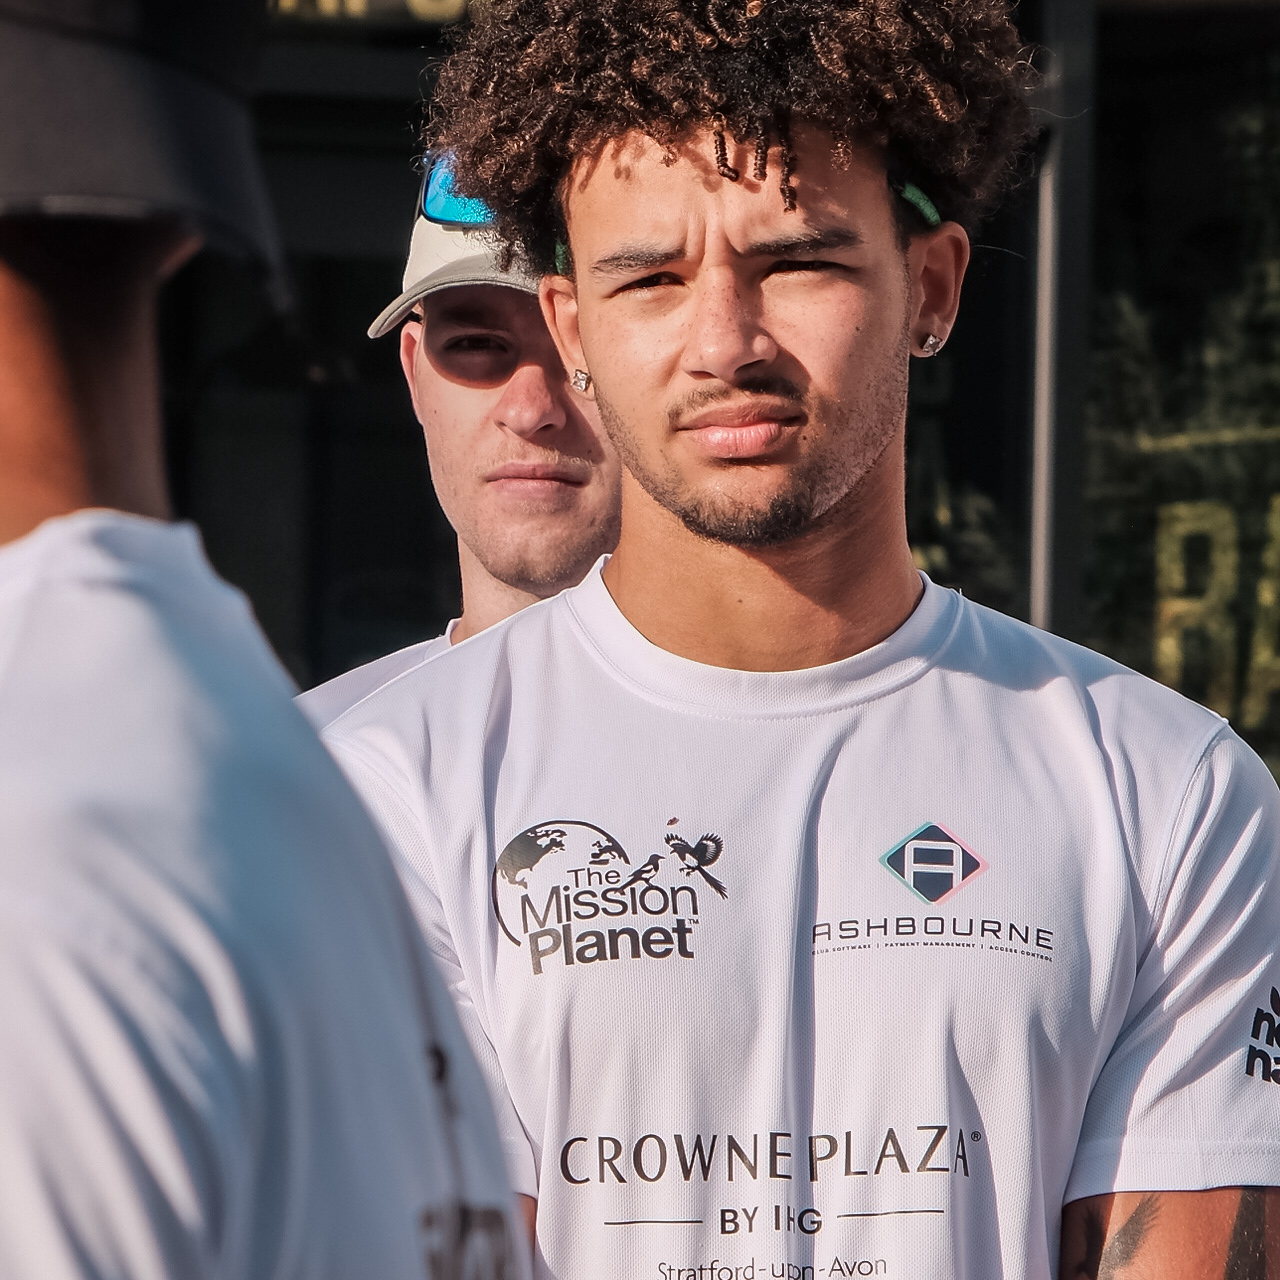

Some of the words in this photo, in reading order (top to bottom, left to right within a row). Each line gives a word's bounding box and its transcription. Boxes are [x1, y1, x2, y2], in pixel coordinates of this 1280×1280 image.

[567, 867, 621, 888] The
[521, 885, 699, 934] Mission
[812, 916, 1054, 951] ASHBOURNE
[832, 944, 872, 952] SOFTWARE
[989, 945, 1018, 954] ACCESS
[1020, 949, 1053, 963] CONTROL
[560, 1131, 793, 1186] CROWNE
[720, 1206, 759, 1235] BY
